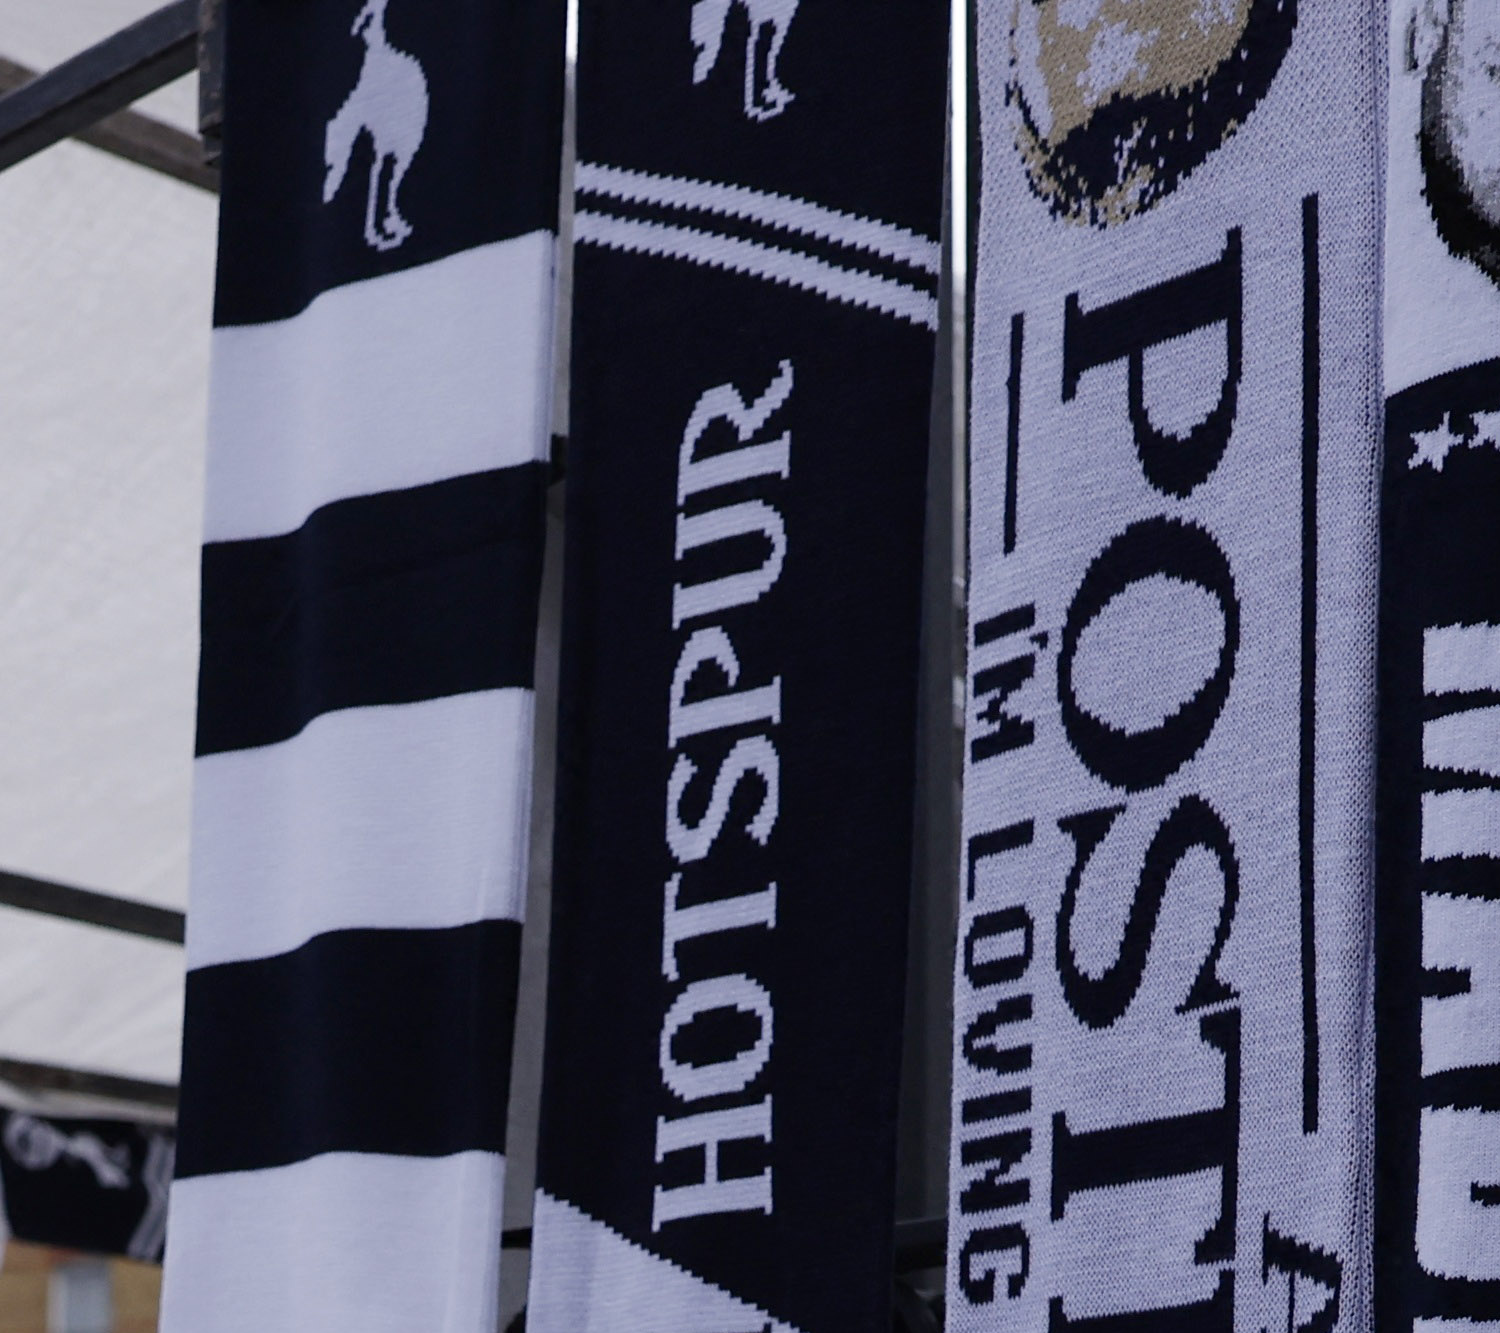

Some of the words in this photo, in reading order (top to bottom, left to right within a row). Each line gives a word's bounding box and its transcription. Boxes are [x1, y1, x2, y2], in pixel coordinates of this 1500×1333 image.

[652, 358, 794, 1233] HOTSPUR
[969, 602, 1049, 766] I'M
[959, 816, 1036, 1306] LOVING
